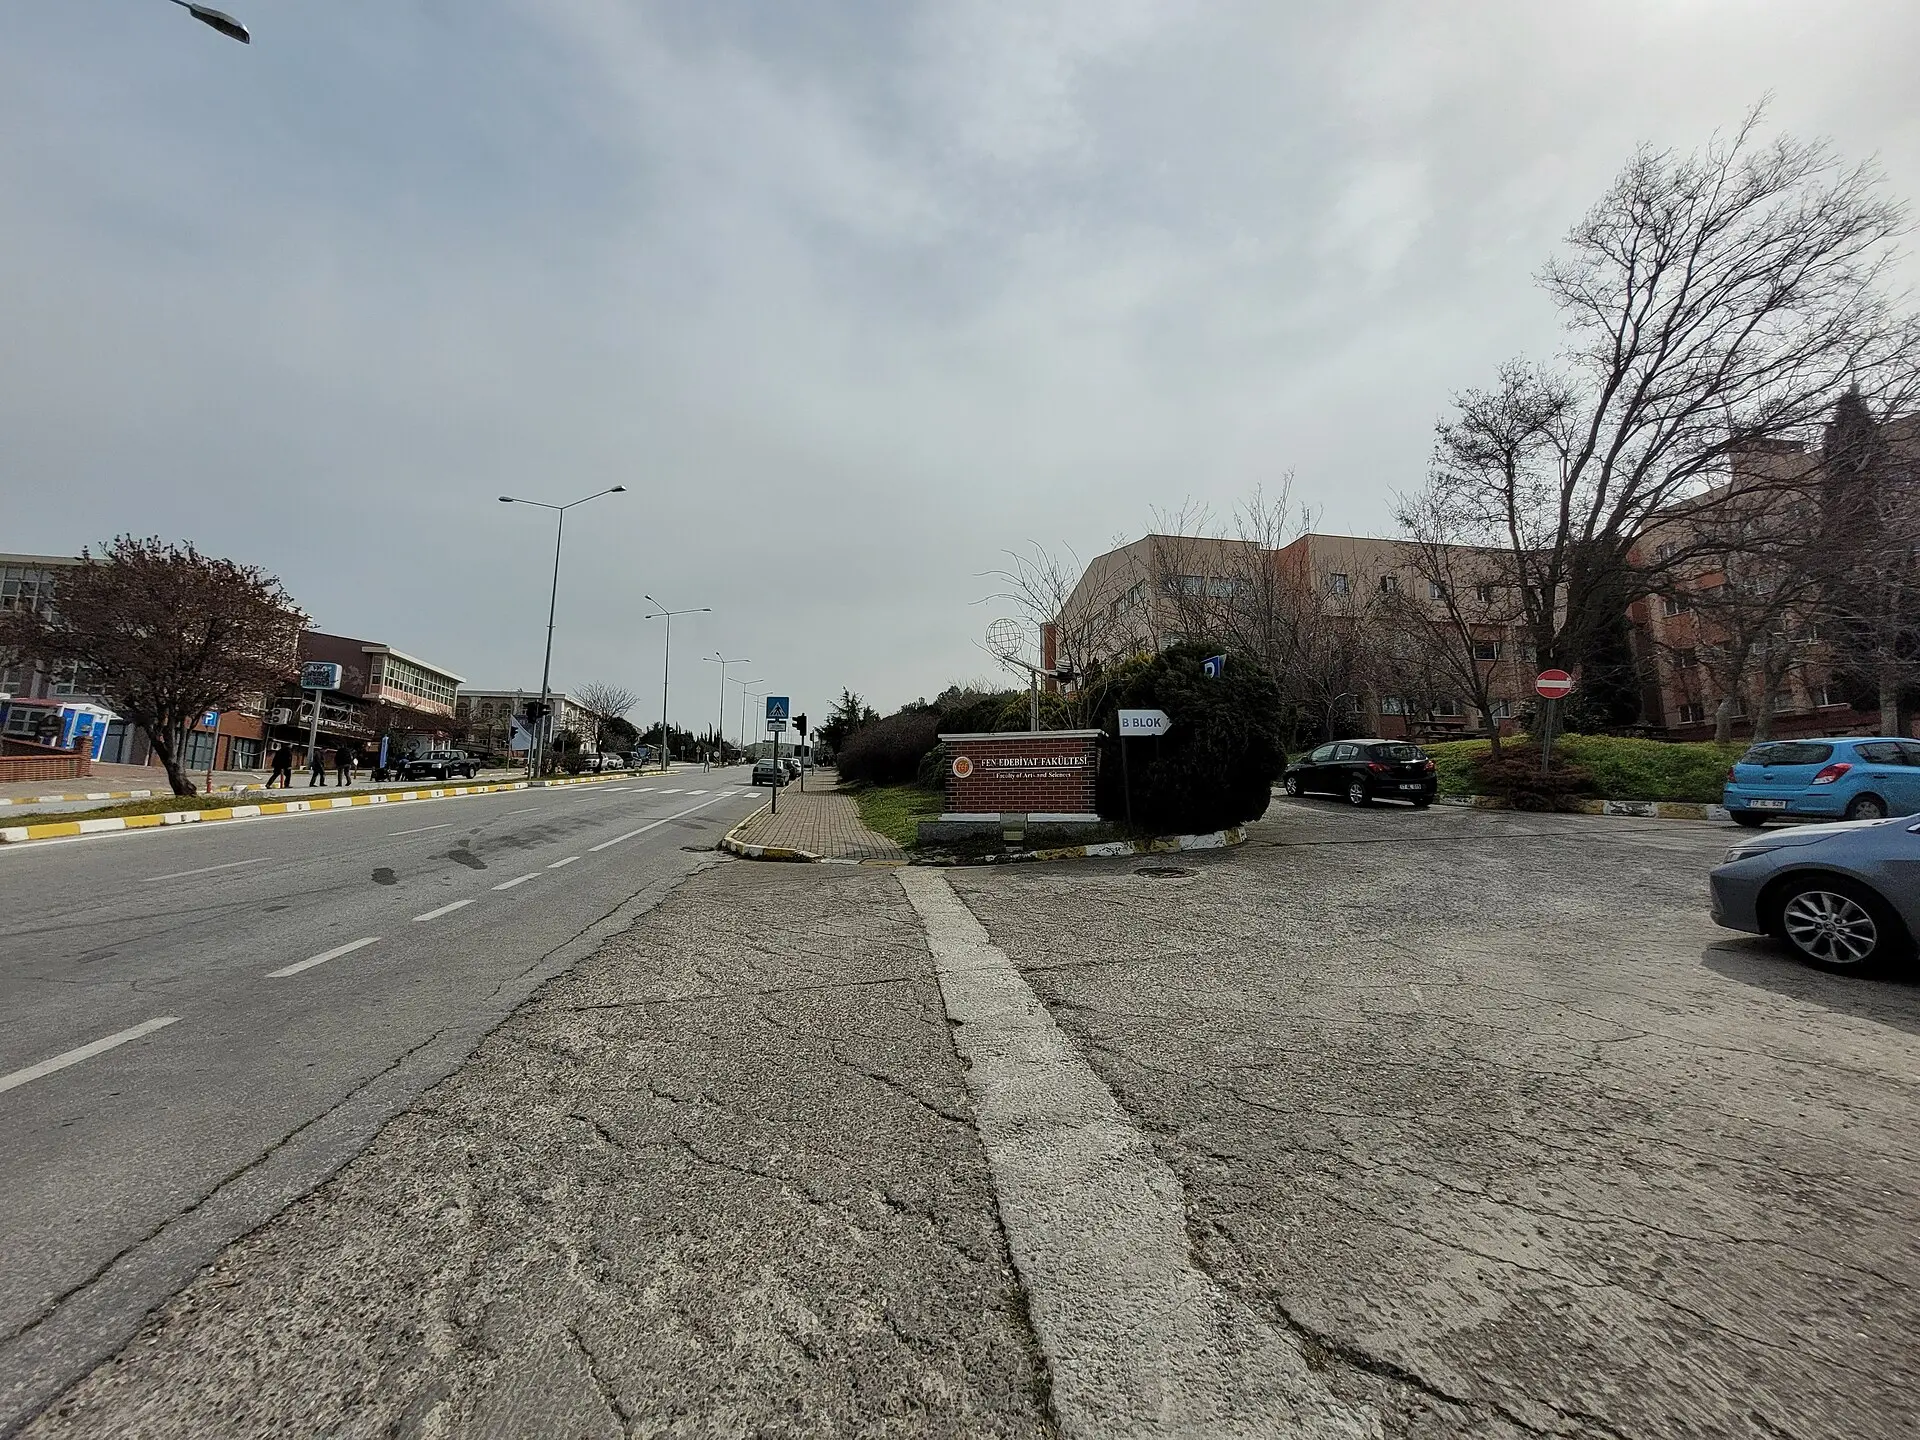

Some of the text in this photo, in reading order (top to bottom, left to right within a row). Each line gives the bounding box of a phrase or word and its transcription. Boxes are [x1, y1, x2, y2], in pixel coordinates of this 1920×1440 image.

[1122, 717, 1162, 728] B BLOK
[1041, 754, 1087, 766] FAKÜLTESİ
